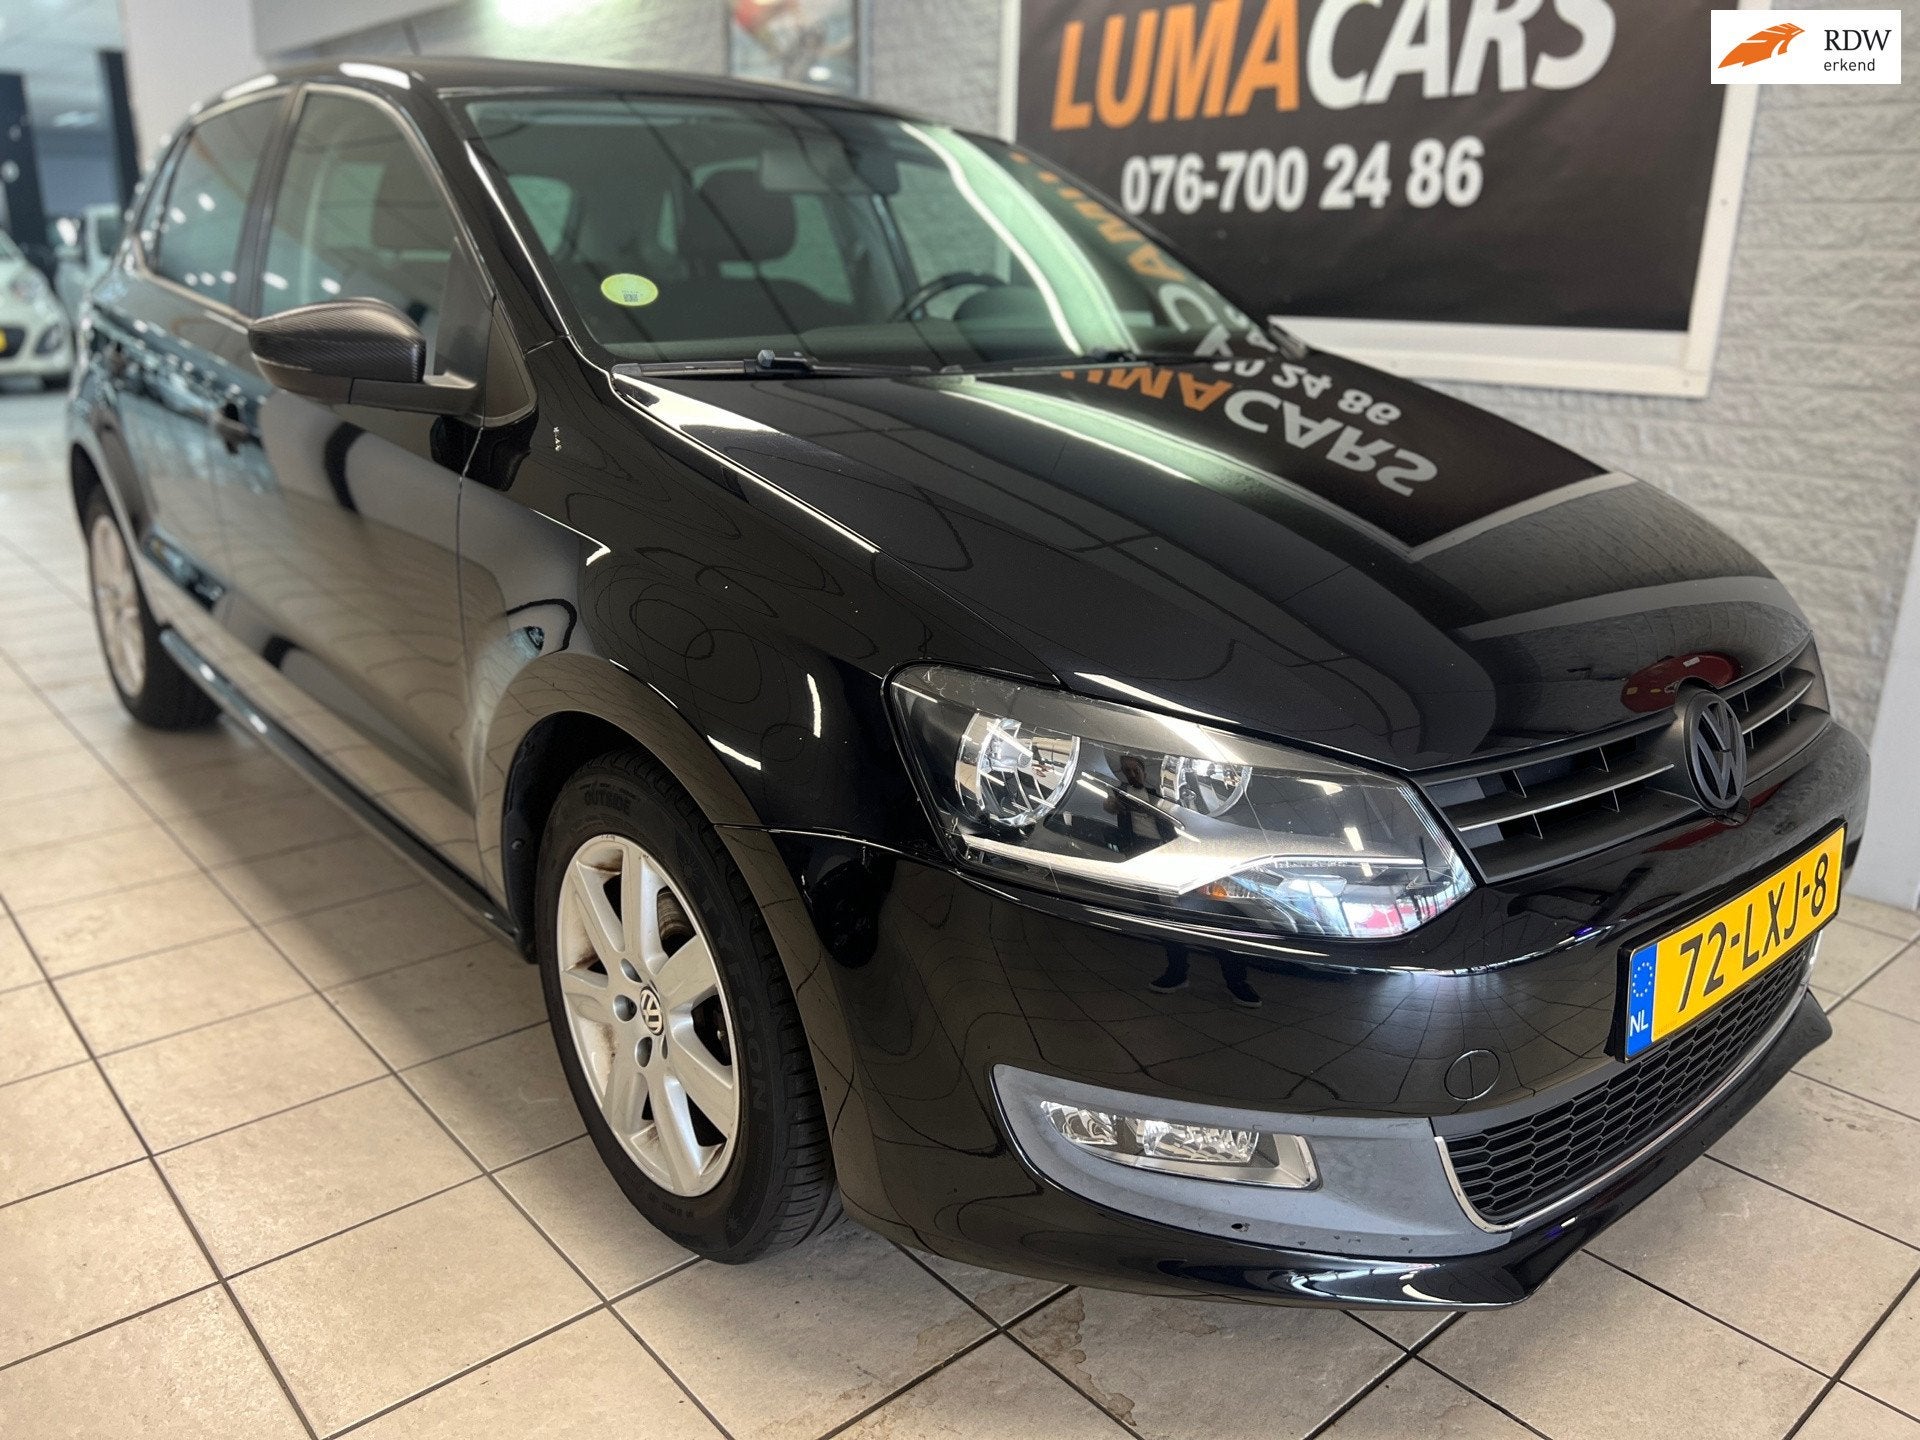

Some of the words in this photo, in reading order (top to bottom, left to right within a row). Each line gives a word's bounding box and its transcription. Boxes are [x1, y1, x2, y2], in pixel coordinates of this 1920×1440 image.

[1120, 146, 1309, 216] 076-700
[1319, 141, 1392, 210] 24
[1406, 135, 1486, 208] 86
[1677, 852, 1829, 1014] 72-LXJ-8
[1629, 1008, 1649, 1037] NL
